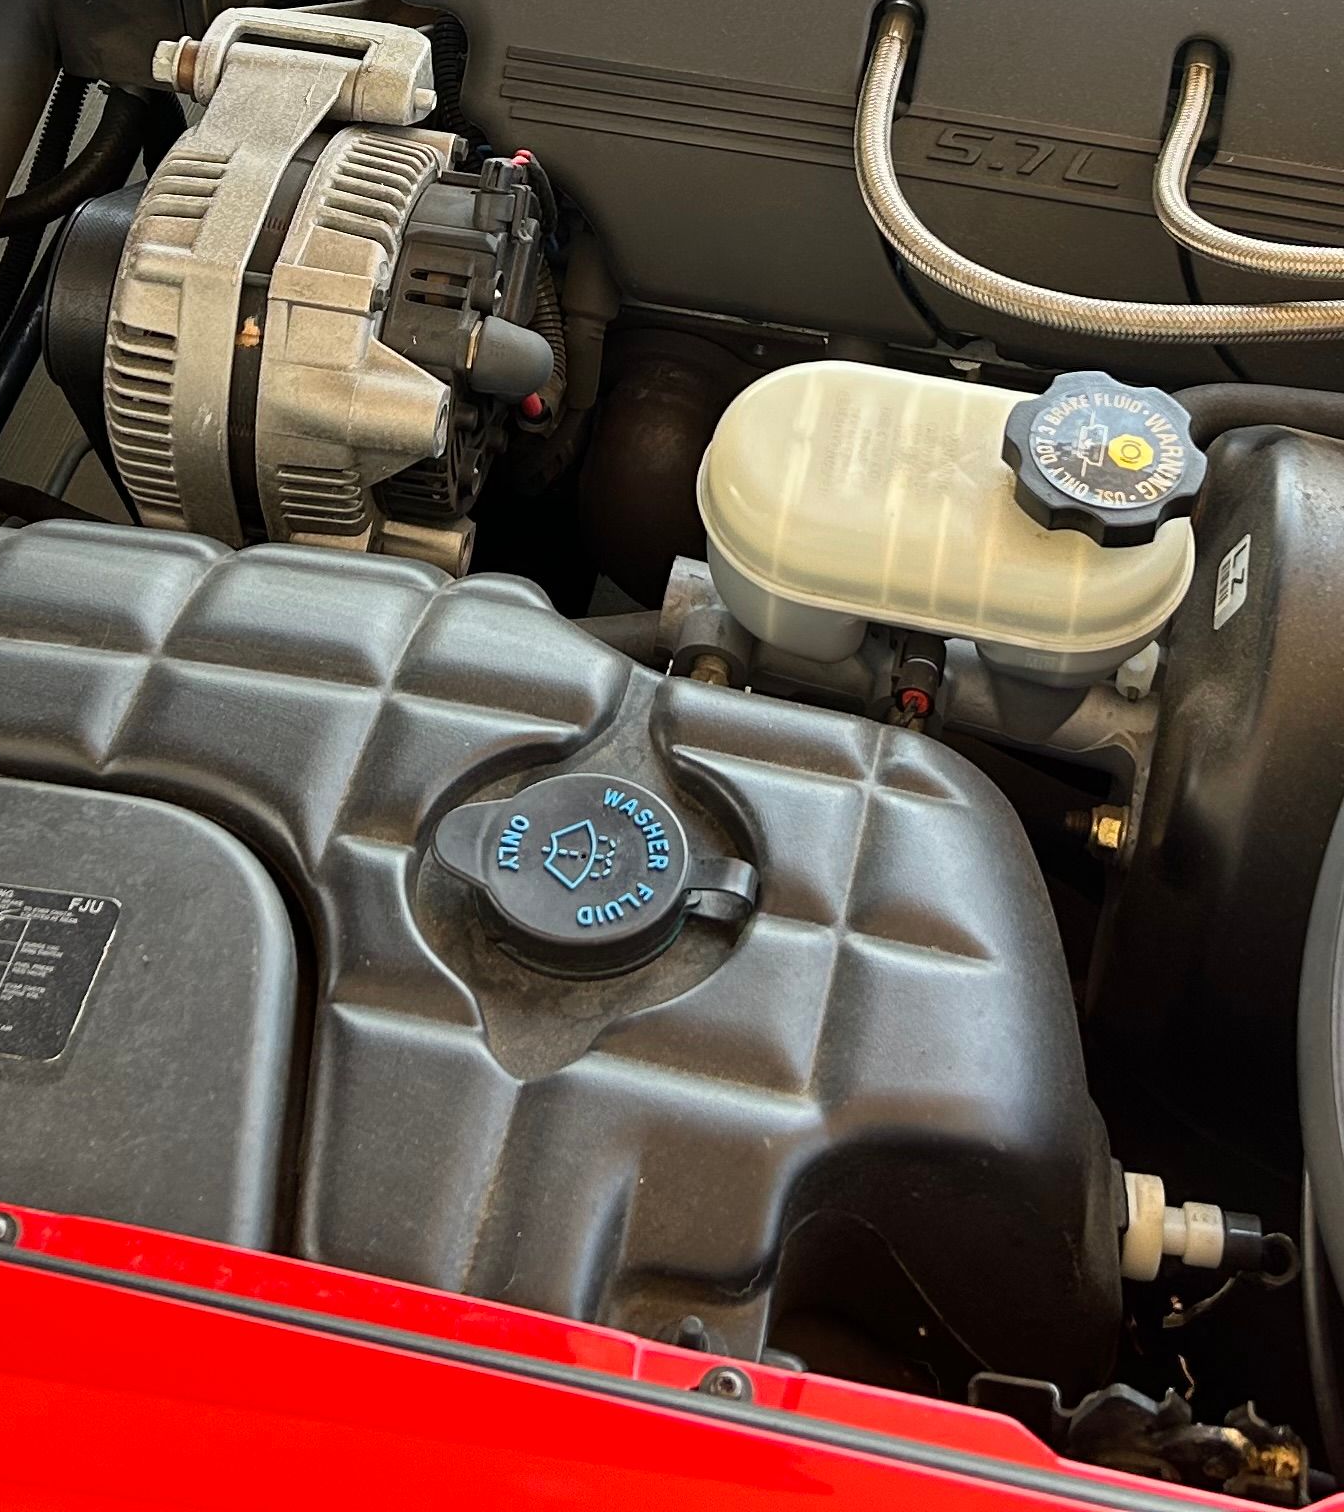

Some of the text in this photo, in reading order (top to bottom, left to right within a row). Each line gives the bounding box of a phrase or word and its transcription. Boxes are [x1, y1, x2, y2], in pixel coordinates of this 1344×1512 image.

[926, 128, 1119, 188] 5.7L
[1035, 391, 1142, 505] USE ONLY DOT 3 BRAKE FLUID
[1134, 412, 1184, 500] WARNING
[497, 786, 671, 926] WASHER FLUID ONLY
[68, 898, 105, 915] FJU
